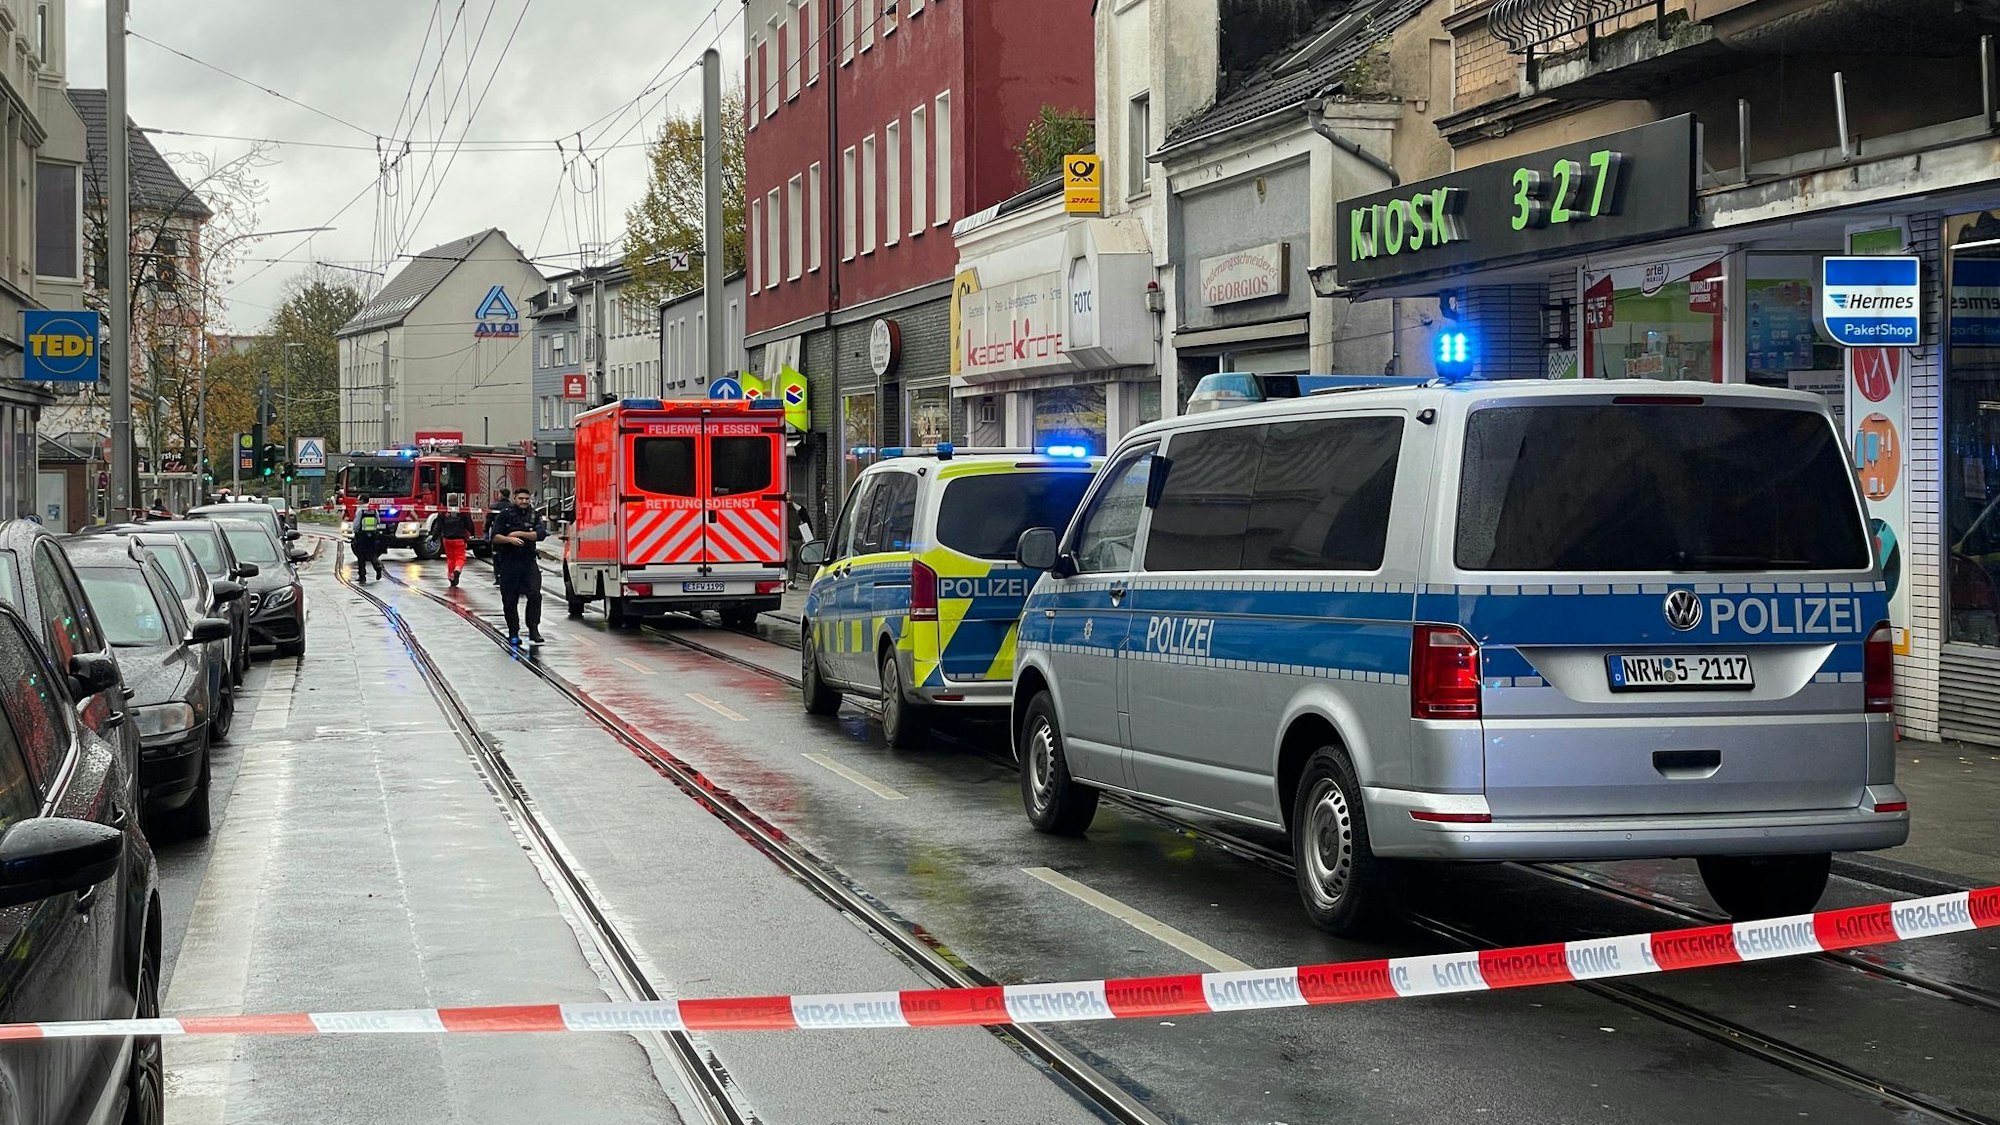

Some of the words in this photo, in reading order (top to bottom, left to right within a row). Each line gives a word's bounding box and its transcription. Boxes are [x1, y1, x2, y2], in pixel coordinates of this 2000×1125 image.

[1351, 186, 1449, 262] KIOSK
[1209, 275, 1269, 303] GEORGIOS
[1689, 280, 1711, 294] WORLD
[1849, 294, 1914, 309] Hermes
[475, 322, 520, 337] ALDI
[1844, 324, 1913, 338] PaketShop
[28, 334, 94, 357] TEDi
[648, 424, 720, 435] FEUERWEHR
[723, 424, 760, 434] ESSEN
[645, 498, 758, 510] RETTUNGSDIENST
[940, 578, 1029, 598] POLIZEI
[1710, 597, 1862, 635] POLIZEI
[1146, 615, 1215, 657] POLIZEI
[1624, 658, 1664, 682] NRW
